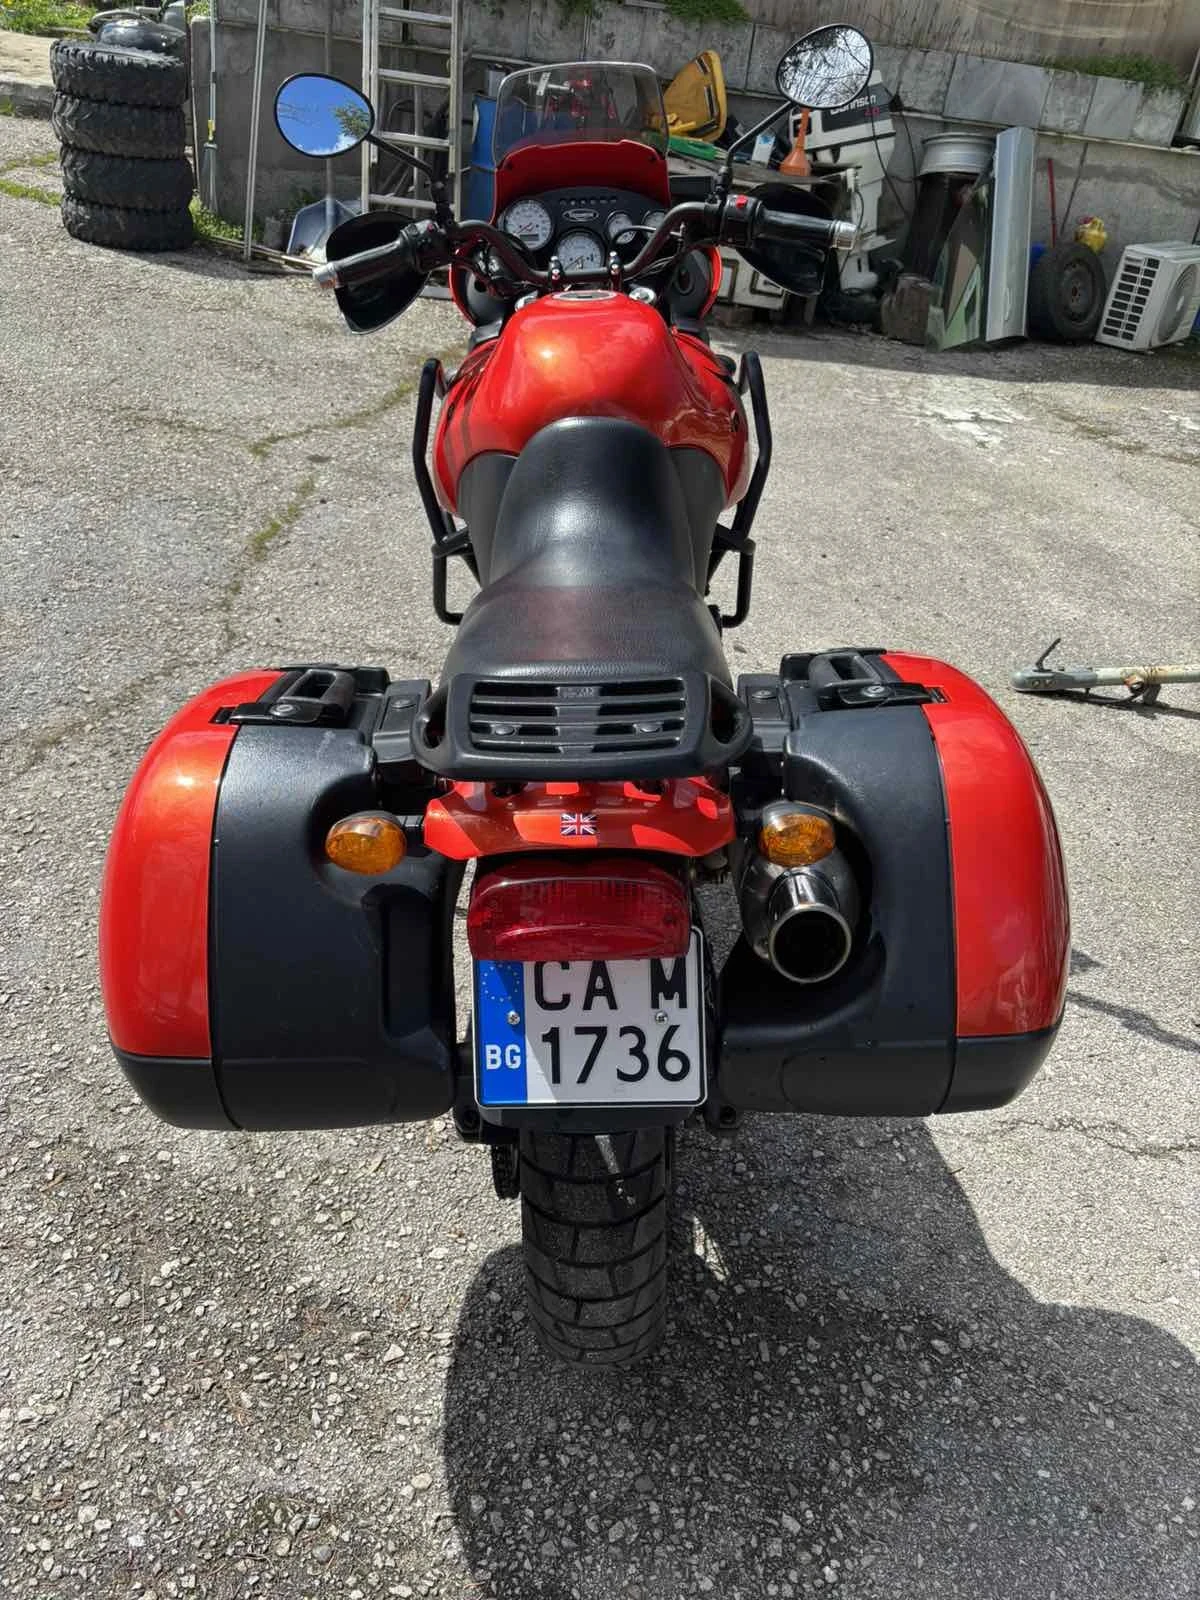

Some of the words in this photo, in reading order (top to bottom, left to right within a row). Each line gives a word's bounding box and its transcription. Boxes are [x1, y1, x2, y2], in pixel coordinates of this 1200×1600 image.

[534, 960, 617, 1011] CA
[650, 957, 688, 1009] M
[485, 1044, 522, 1070] BG
[541, 1024, 691, 1085] 1736
